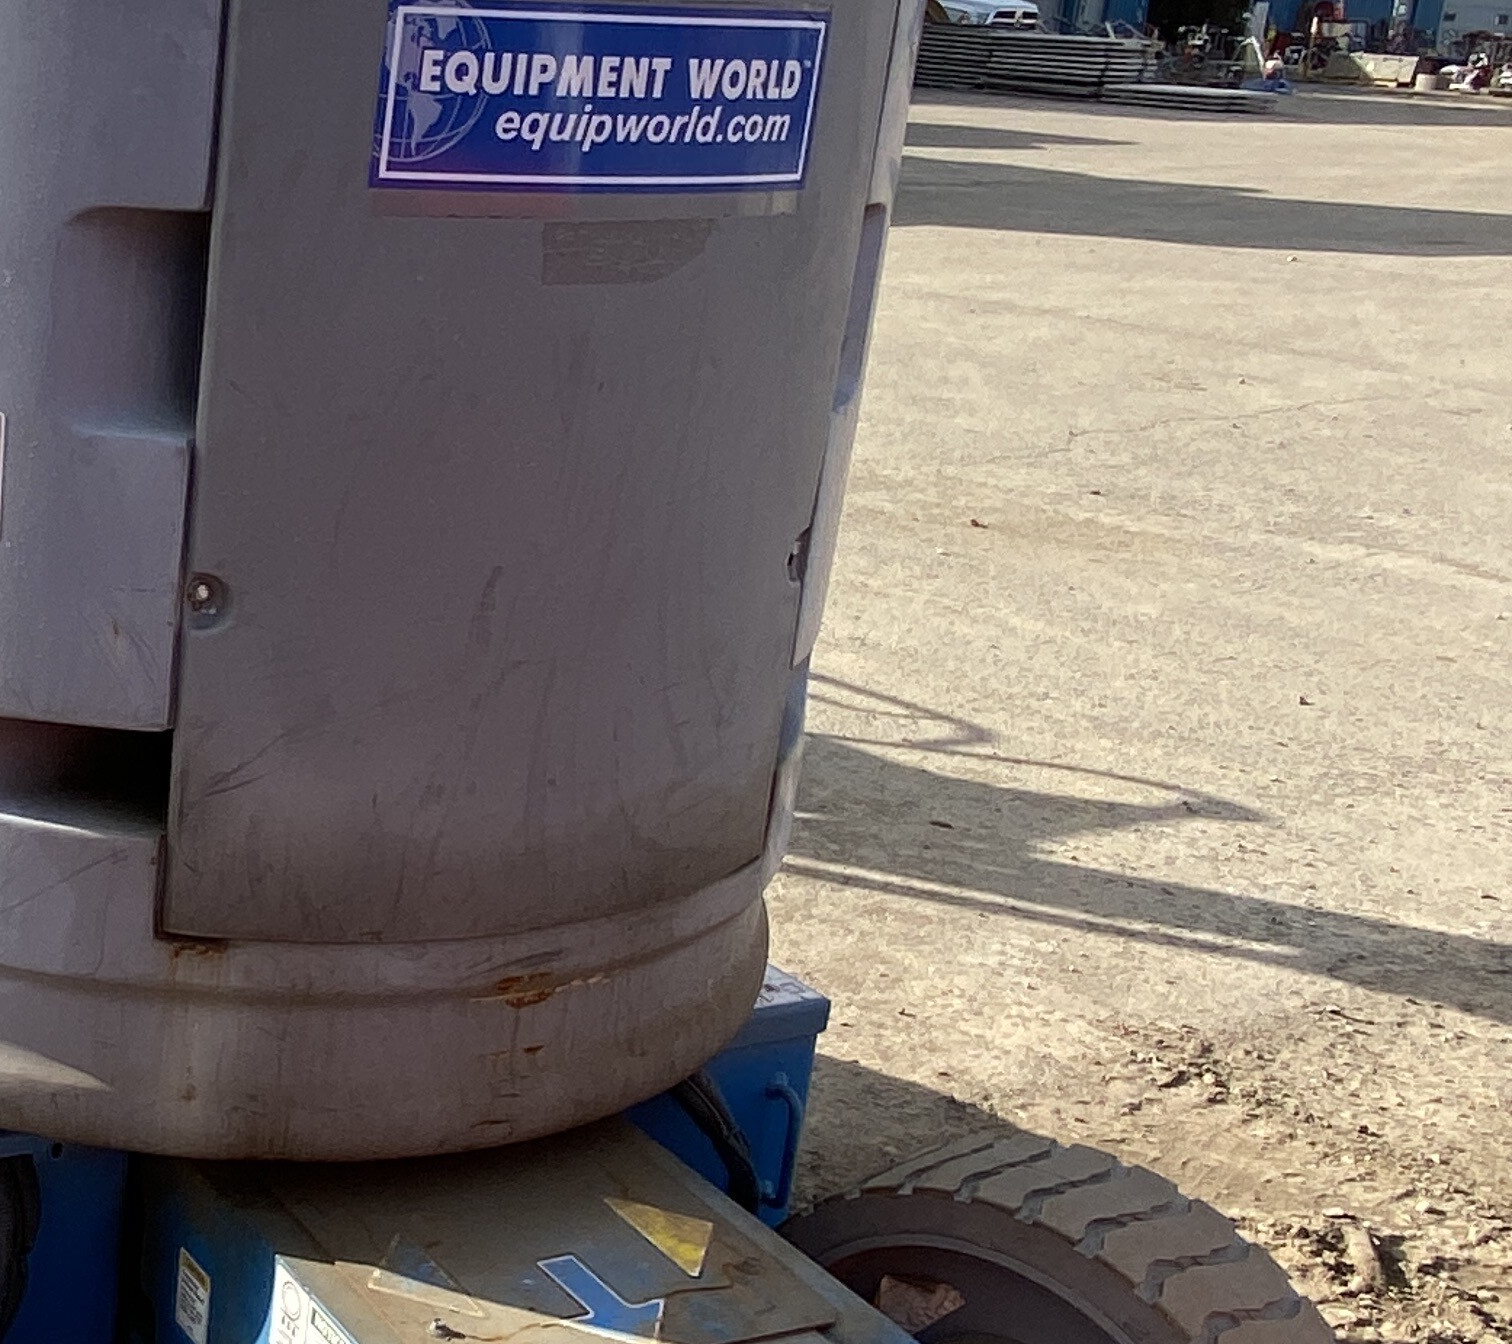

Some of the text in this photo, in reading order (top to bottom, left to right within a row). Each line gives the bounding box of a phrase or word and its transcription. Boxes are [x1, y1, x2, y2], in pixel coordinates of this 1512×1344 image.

[419, 48, 804, 102] EQUIPMENT WORLD
[494, 103, 792, 153] equipworld.com
